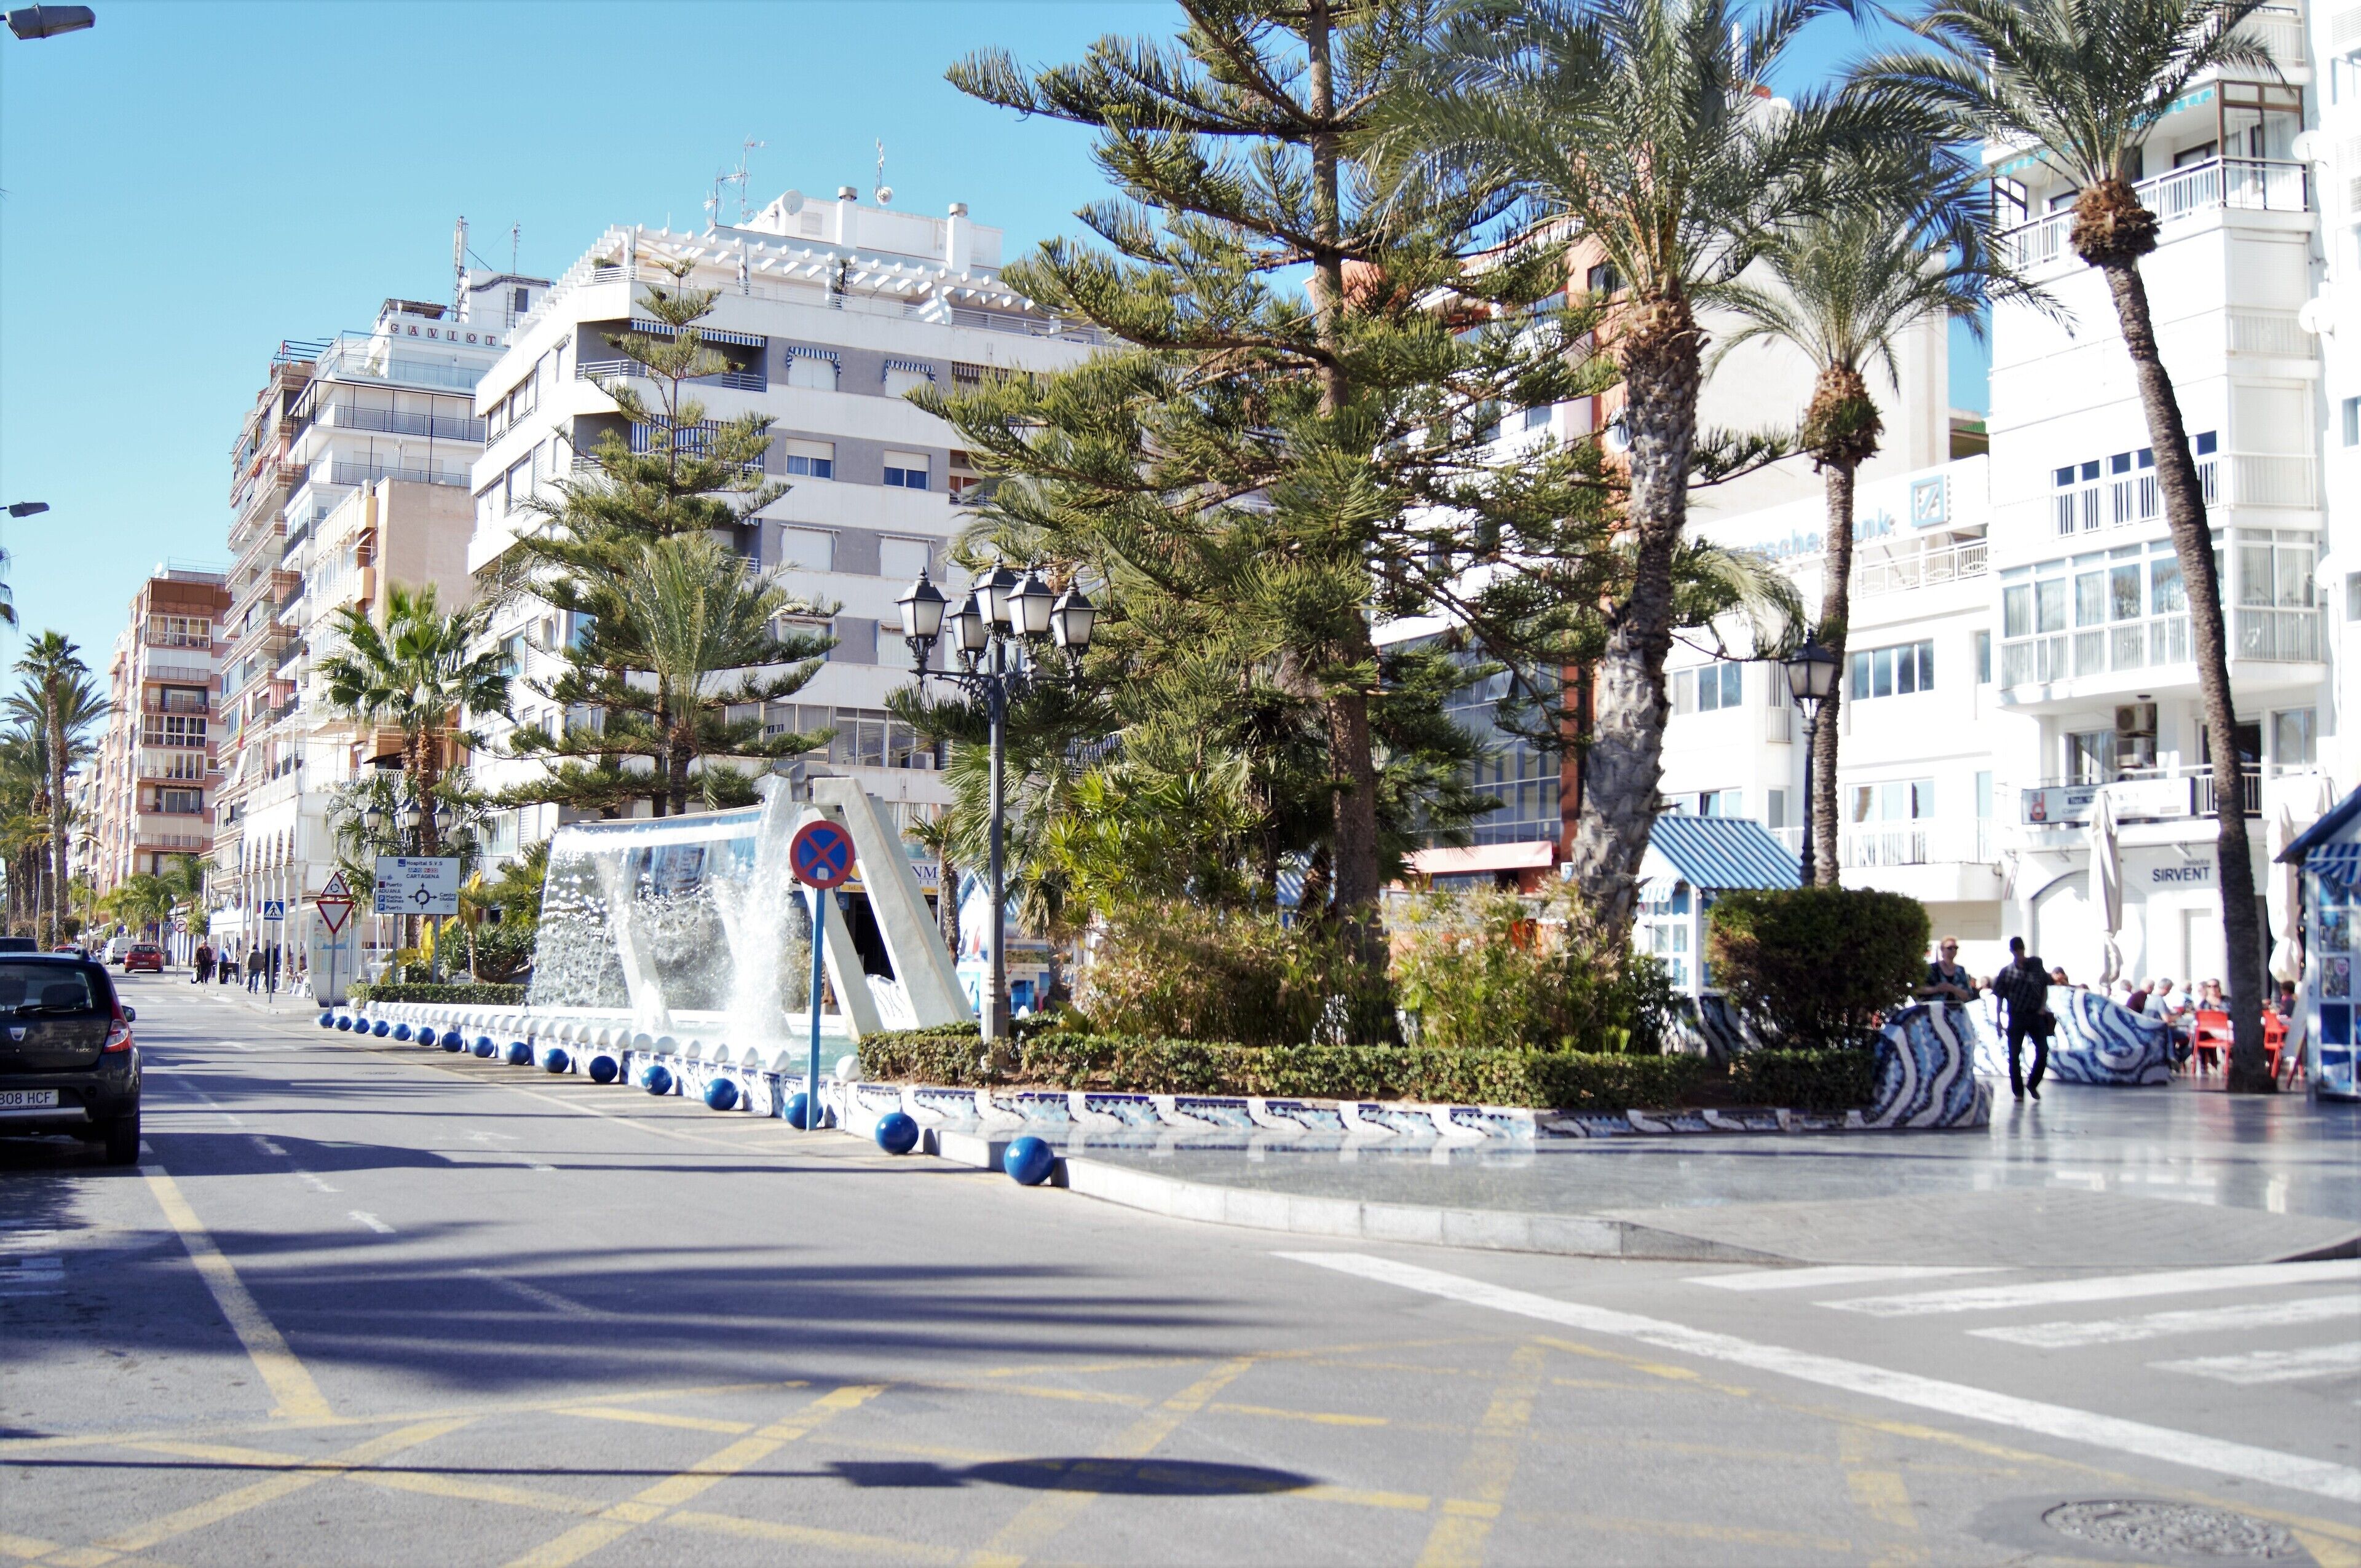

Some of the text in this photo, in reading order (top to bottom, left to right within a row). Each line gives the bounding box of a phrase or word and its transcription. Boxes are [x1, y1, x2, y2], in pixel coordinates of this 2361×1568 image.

[1852, 507, 1891, 541] ank
[2153, 867, 2210, 882] SIRVENT
[28, 1092, 52, 1104] HCF
